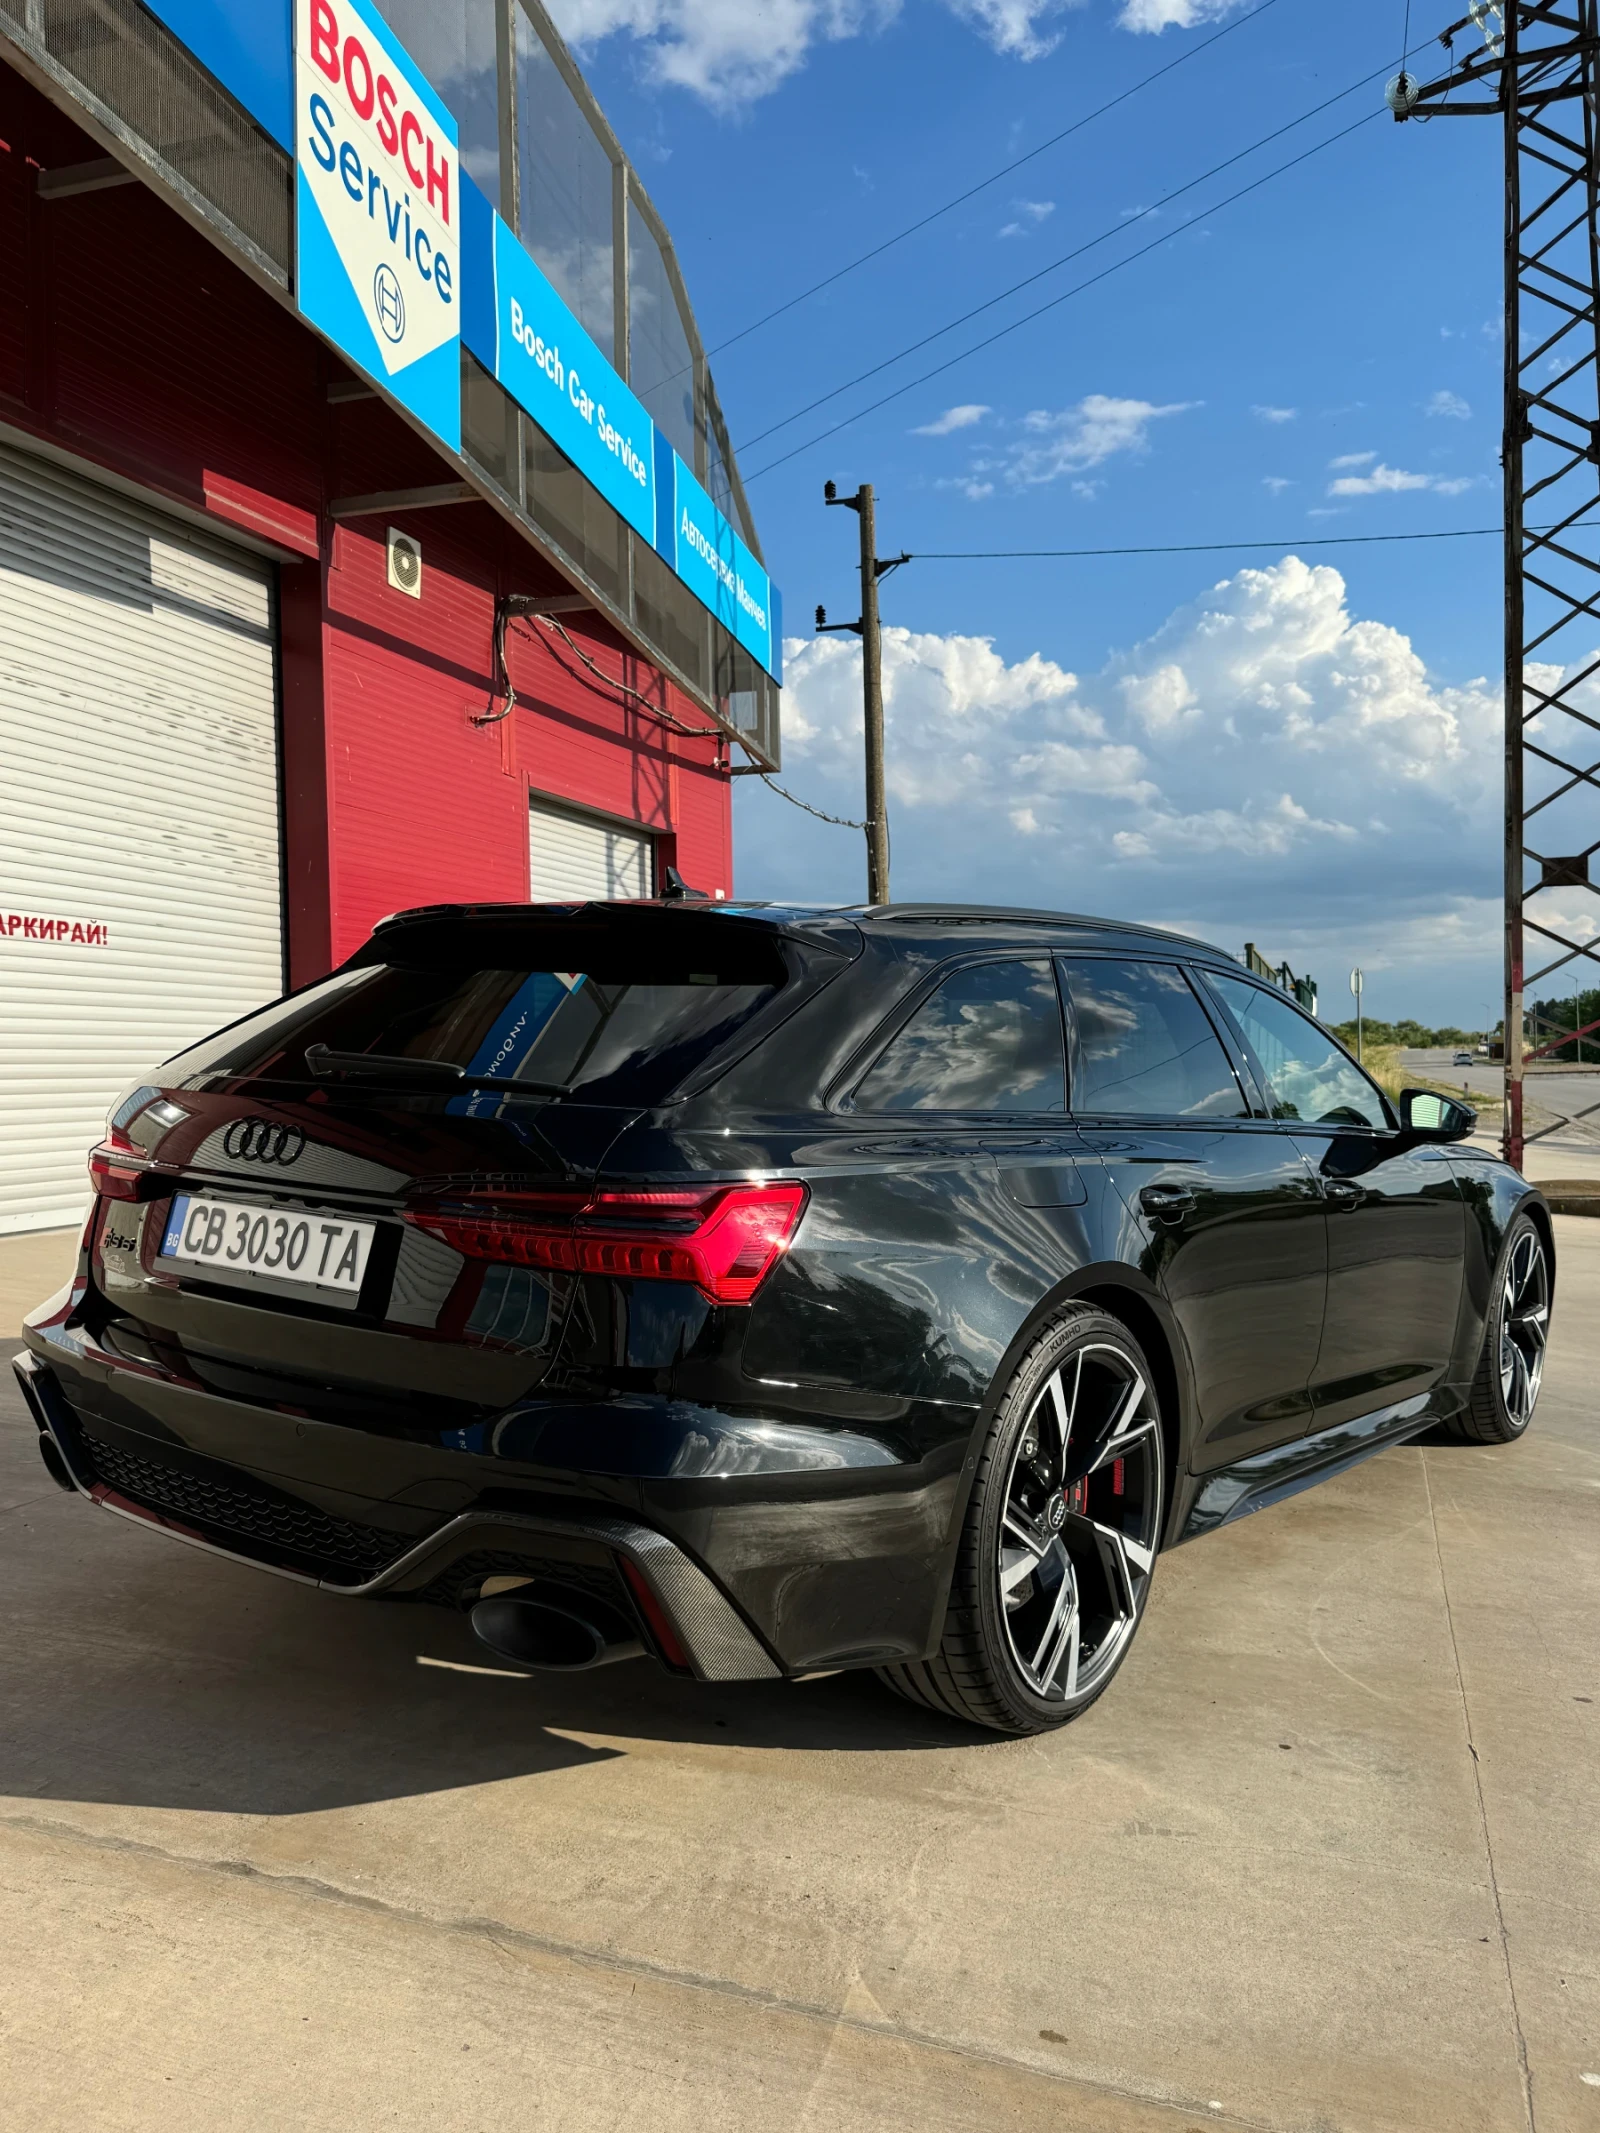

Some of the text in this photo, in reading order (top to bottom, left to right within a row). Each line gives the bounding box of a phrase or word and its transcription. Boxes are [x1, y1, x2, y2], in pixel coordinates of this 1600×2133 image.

[310, 0, 450, 226] BOSCH
[309, 92, 452, 304] Service
[510, 296, 647, 487] Bosch Car Service
[165, 1232, 179, 1248] BG
[184, 1205, 359, 1283] CB 3030 TA
[1049, 1324, 1081, 1353] KUMHO
